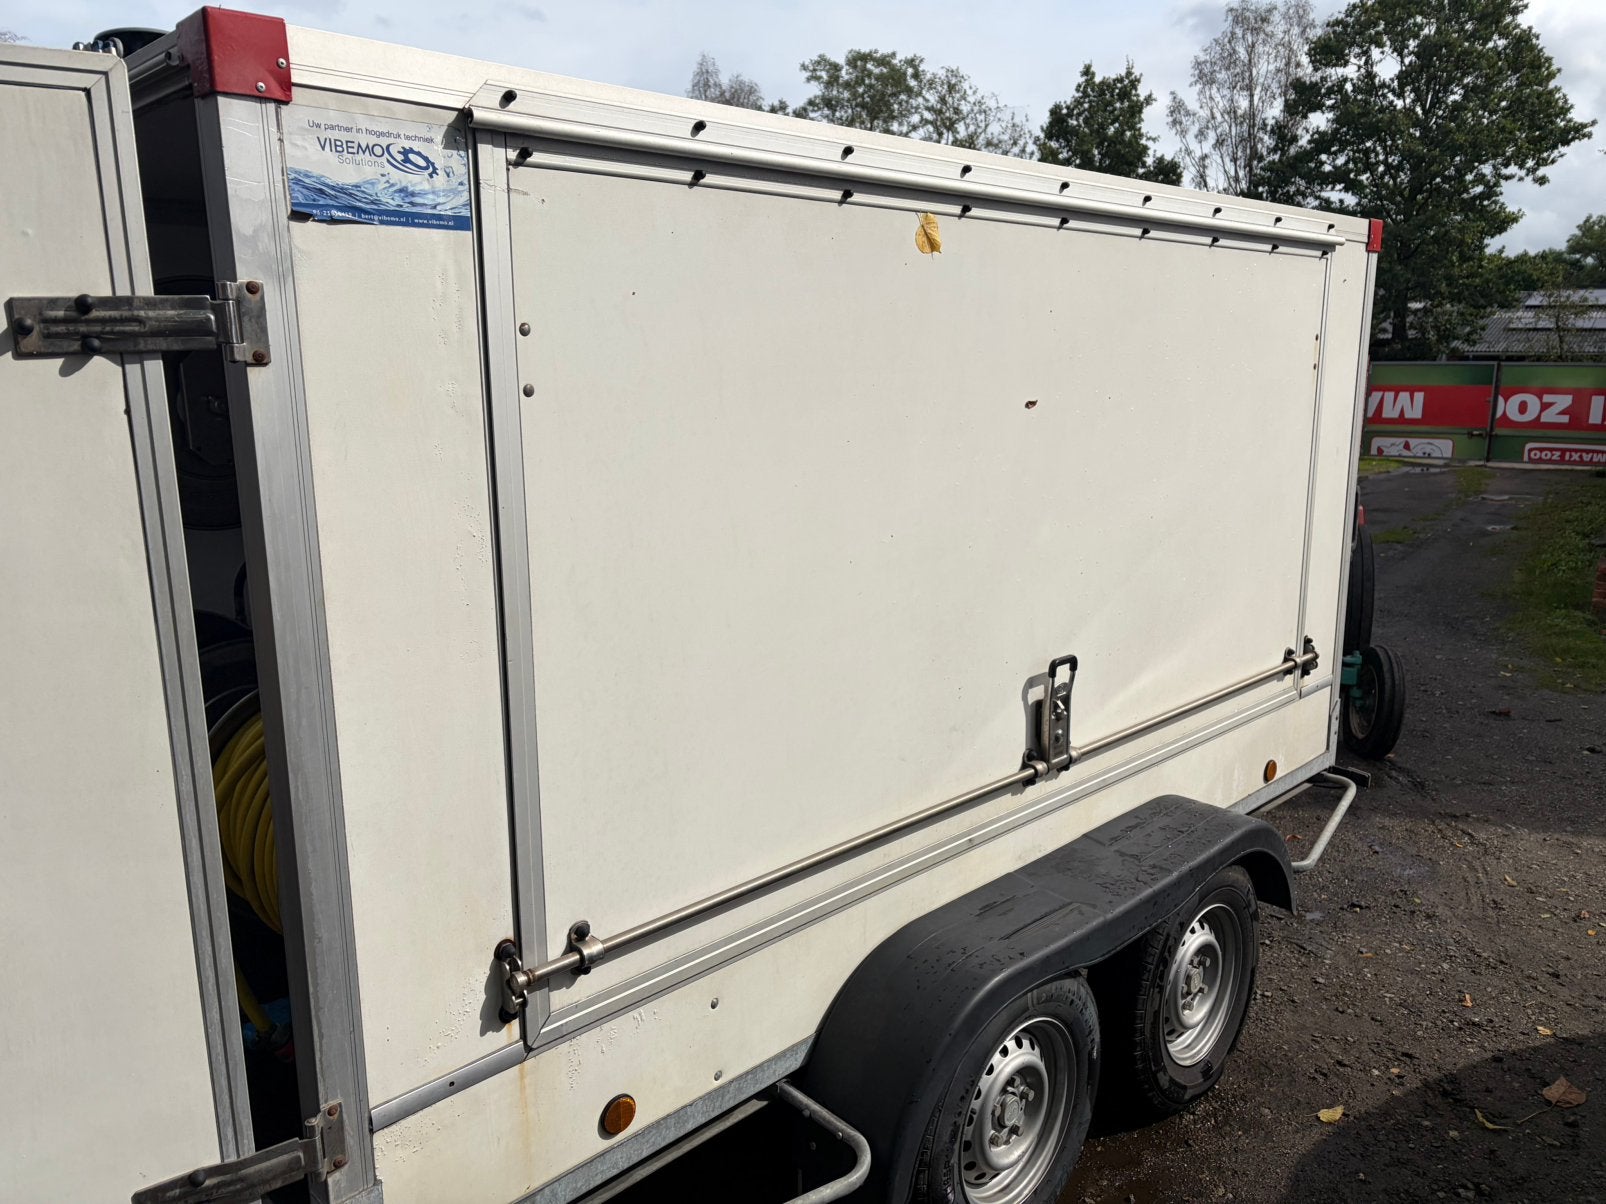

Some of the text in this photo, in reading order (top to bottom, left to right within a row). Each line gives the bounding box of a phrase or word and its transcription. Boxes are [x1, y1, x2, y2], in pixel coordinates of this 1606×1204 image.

[307, 119, 435, 144] Uw partner in hogedruk techniek
[317, 136, 385, 158] VIBEMO
[337, 155, 386, 169] Solutions
[1496, 393, 1573, 423] ZO
[1530, 450, 1562, 461] ZOO
